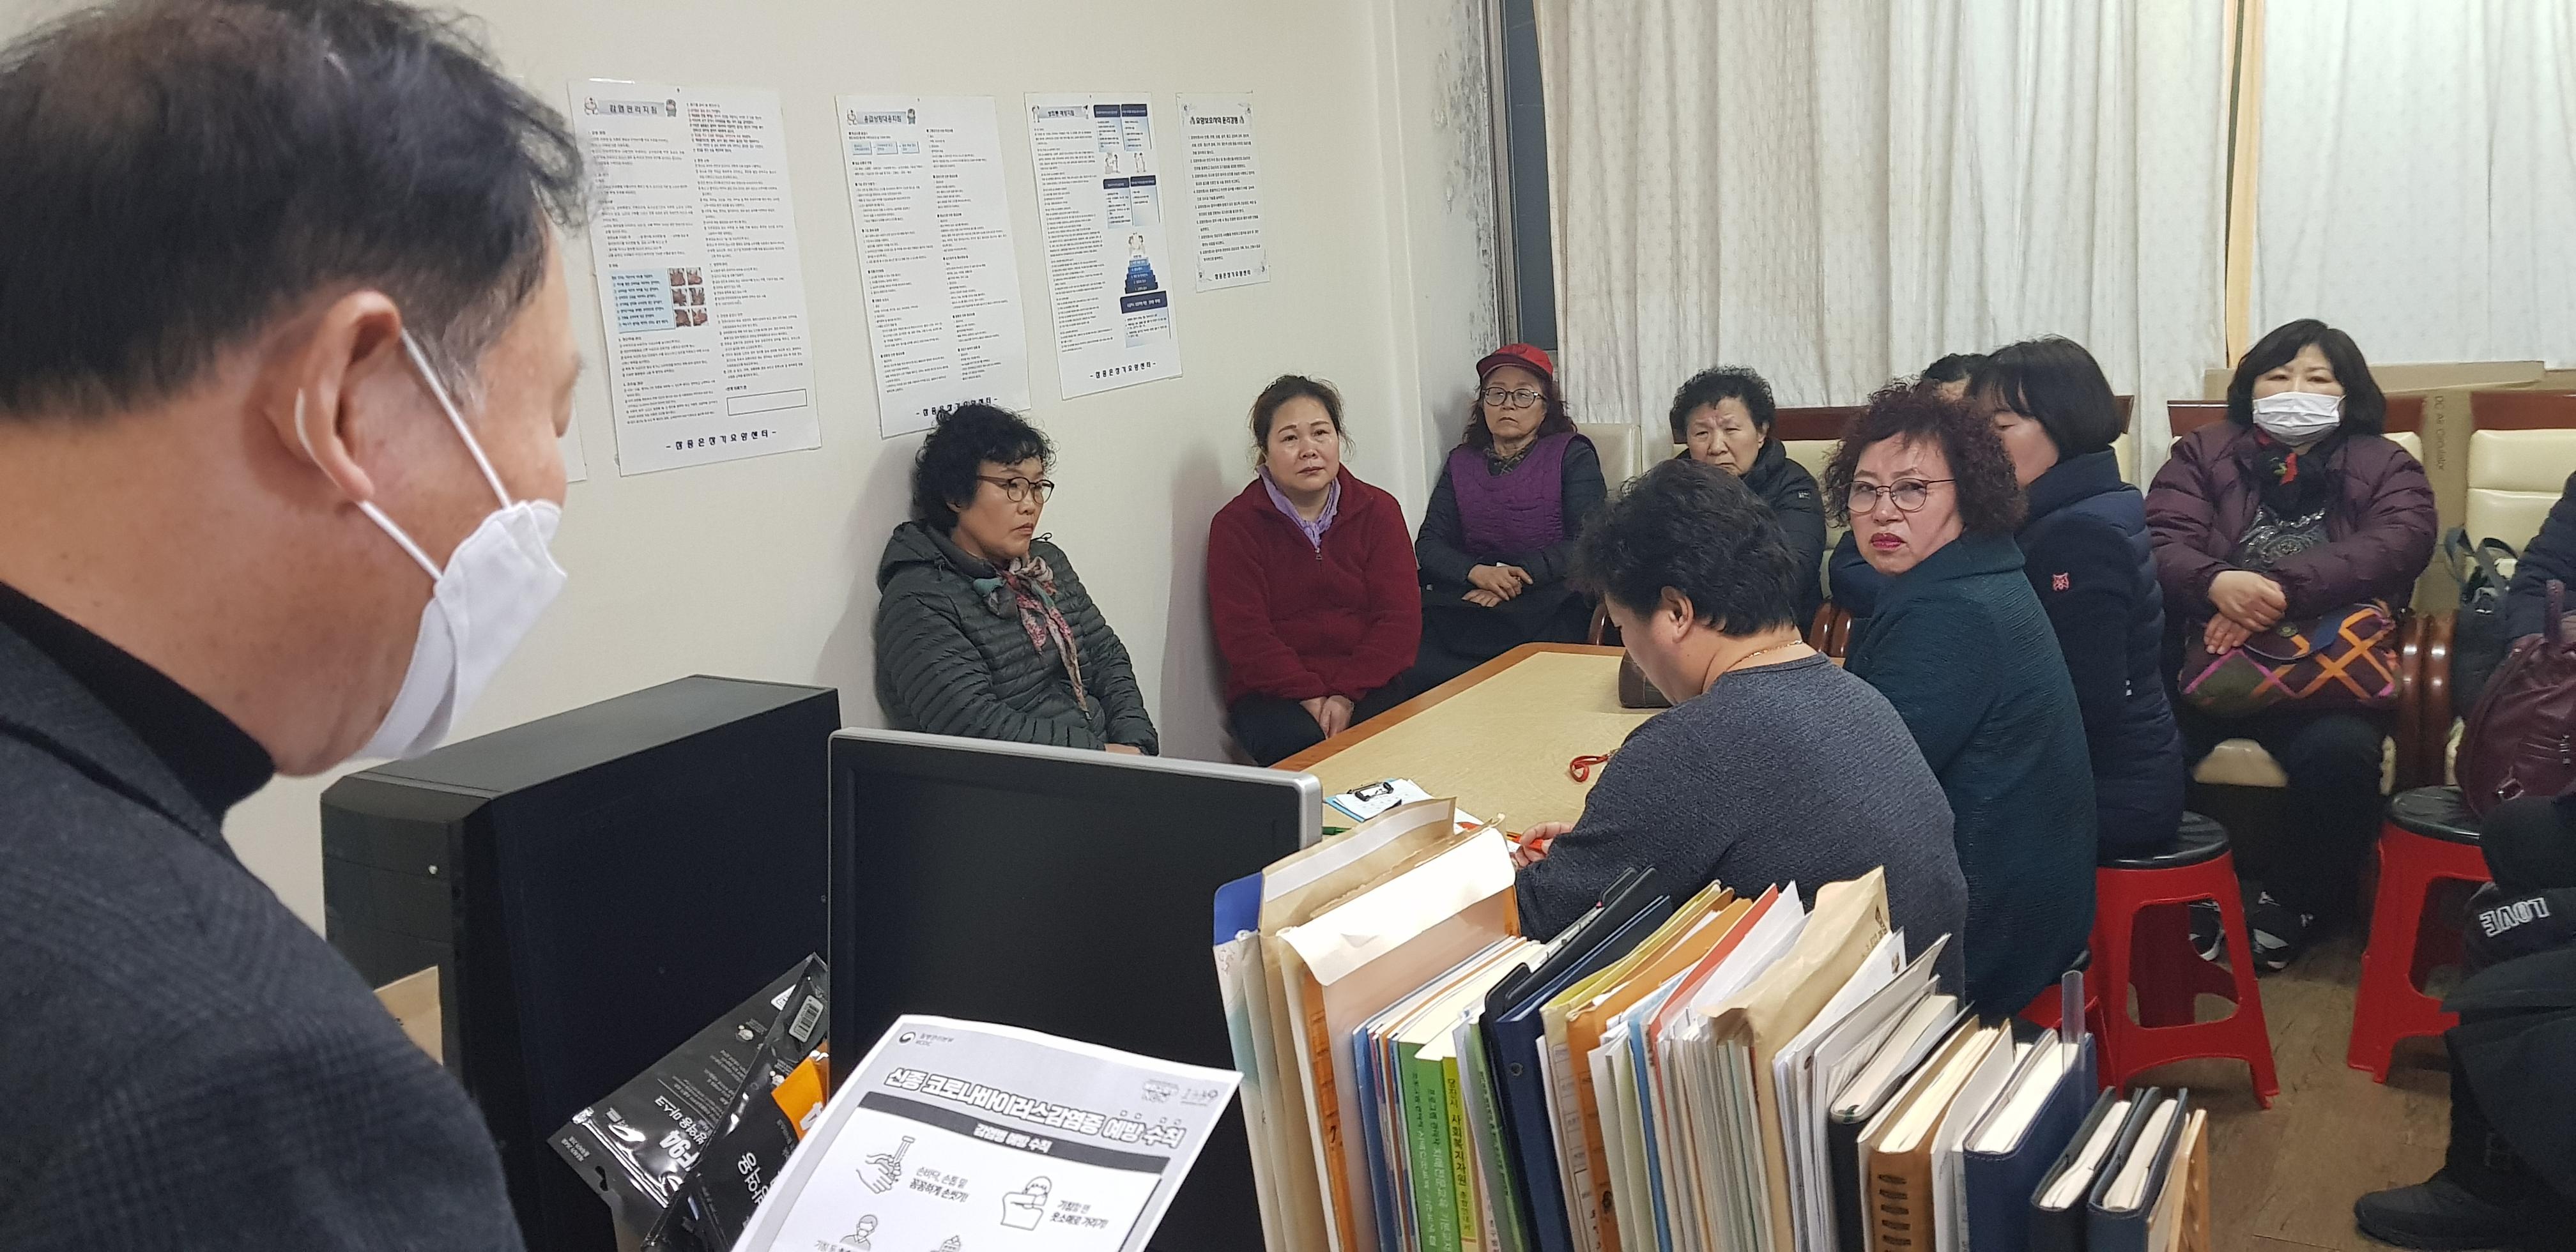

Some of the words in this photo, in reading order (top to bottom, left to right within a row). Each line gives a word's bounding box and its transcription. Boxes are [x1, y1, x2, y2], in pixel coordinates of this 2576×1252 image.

[609, 103, 658, 114] 감염관리지침
[2479, 897, 2550, 938] LOVE
[654, 1094, 684, 1122] 마스크
[884, 1067, 928, 1091] 신종
[921, 1074, 1107, 1134] 코로나바이러스감염증
[1103, 1116, 1144, 1143] 예방
[1142, 1124, 1185, 1149] 수칙
[679, 1115, 709, 1146] 방역용
[974, 1122, 1009, 1143] 감염병
[1005, 1131, 1031, 1148] 예방
[1028, 1138, 1053, 1154] 수칙
[658, 1127, 701, 1172] F94
[1452, 1114, 1468, 1186] 사회복지자원
[909, 1178, 943, 1196] 꼼꼼하게
[1049, 1212, 1082, 1226] 옷소매로
